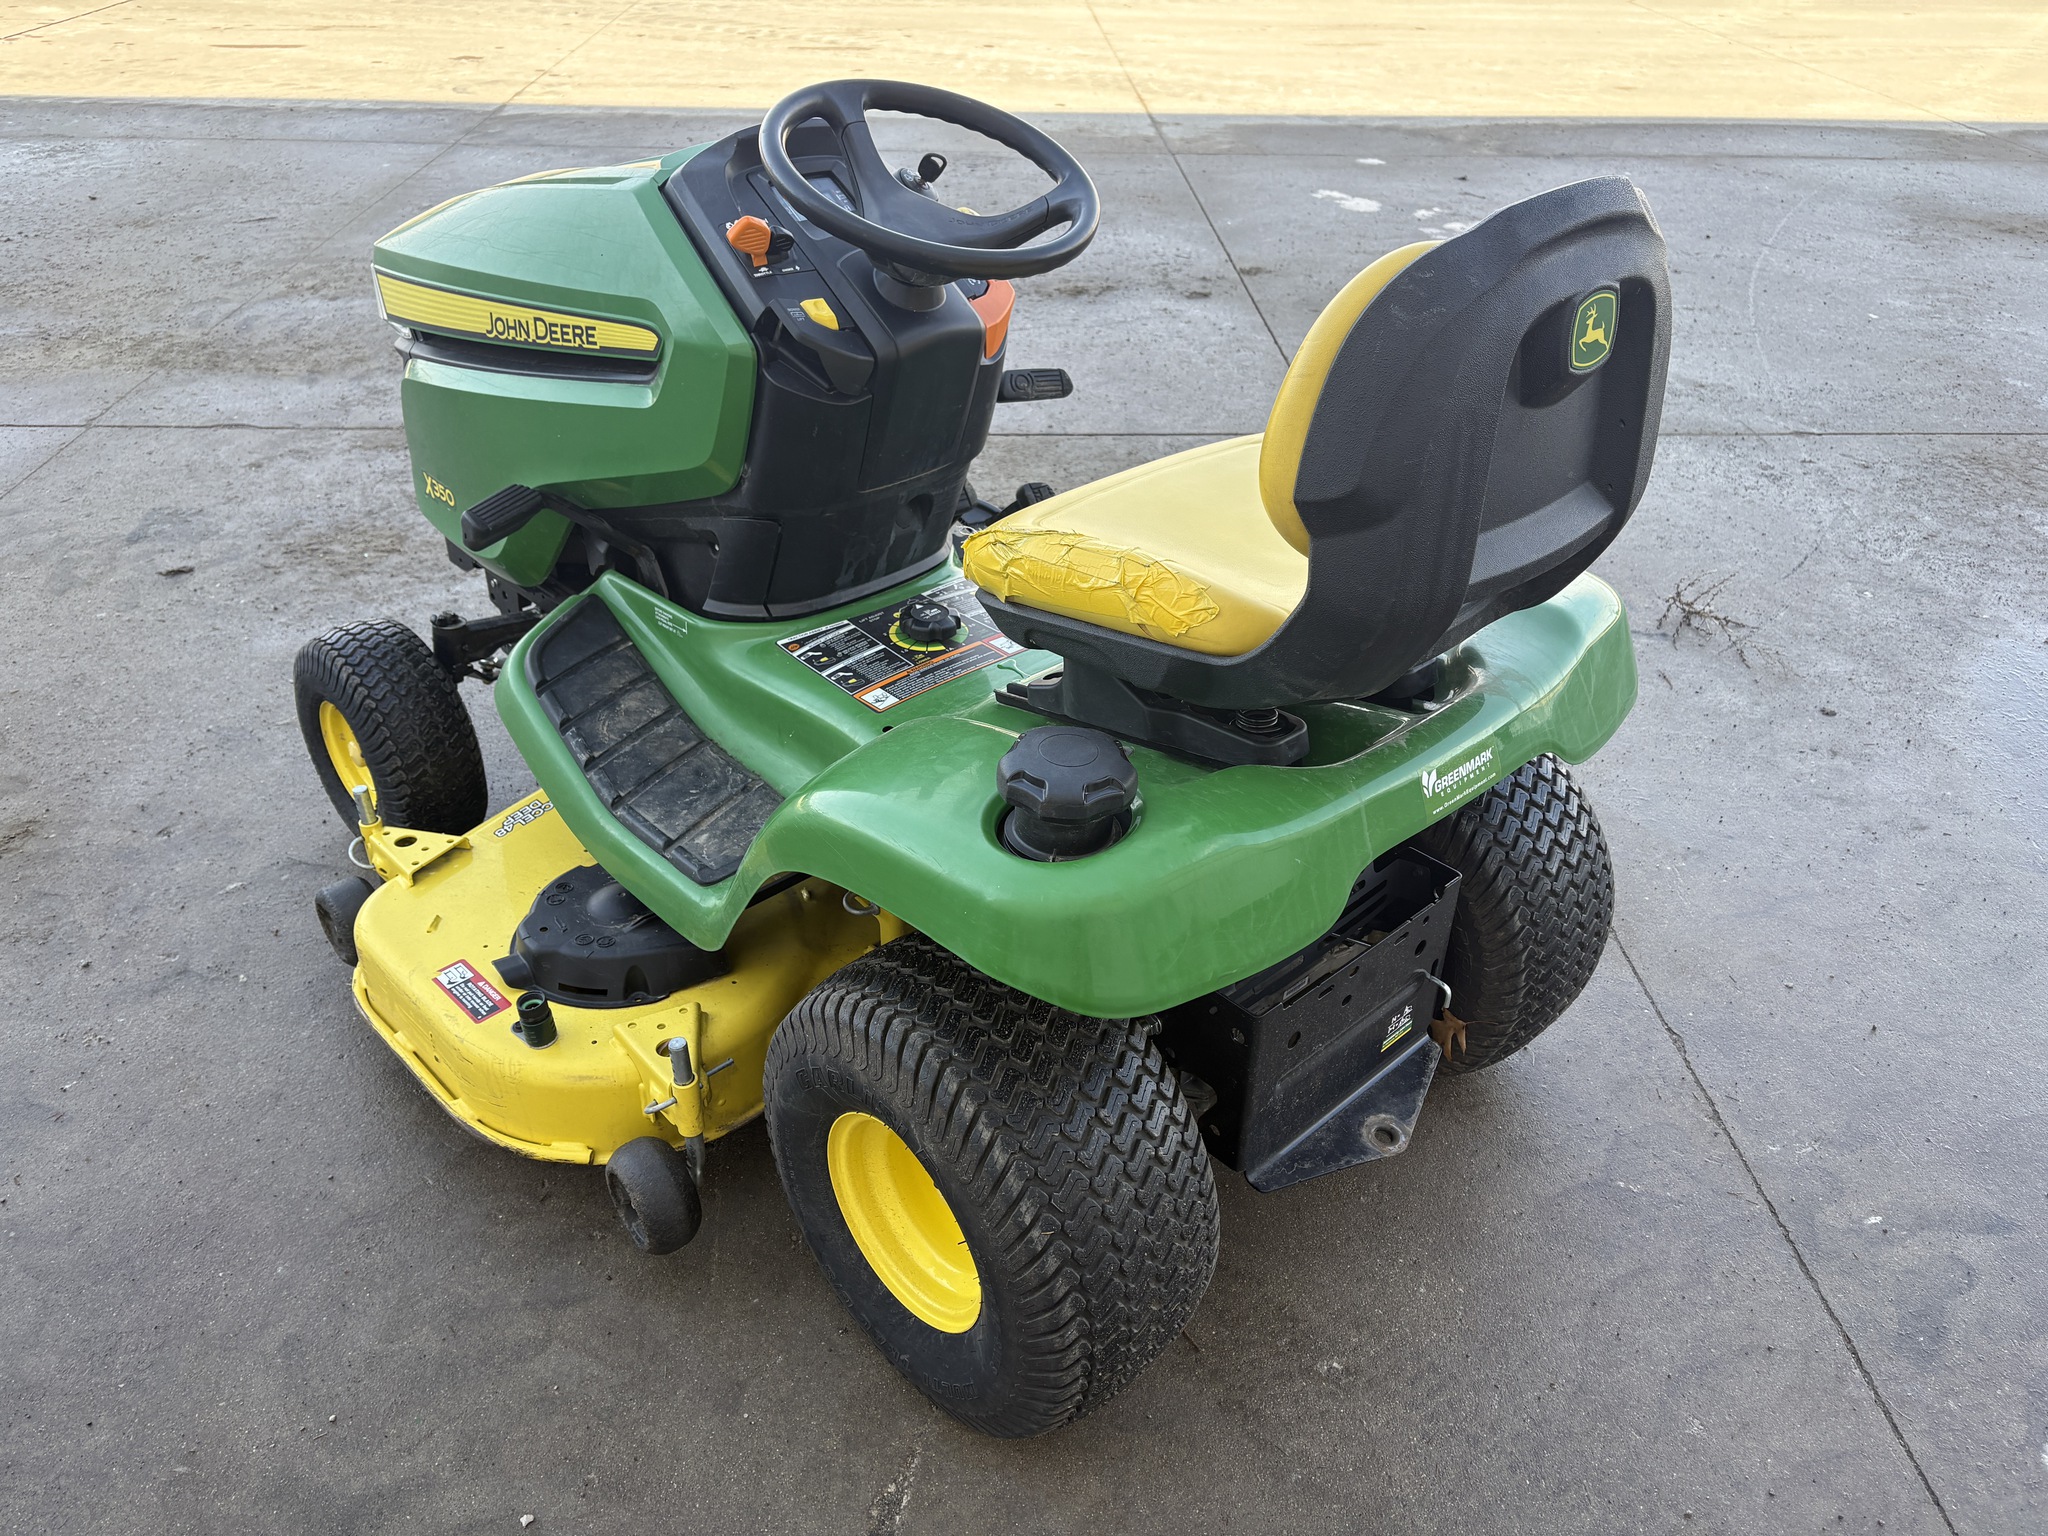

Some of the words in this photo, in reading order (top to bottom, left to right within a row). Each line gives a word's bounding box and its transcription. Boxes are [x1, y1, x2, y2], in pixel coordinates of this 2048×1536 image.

[486, 311, 531, 341] JOHN
[532, 316, 599, 349] DEERE
[422, 471, 456, 507] X350
[1434, 746, 1494, 793] GREENMARK
[1440, 762, 1491, 797] EQUIPMENT
[502, 799, 543, 827] DEEP
[482, 982, 502, 1002] DANGER
